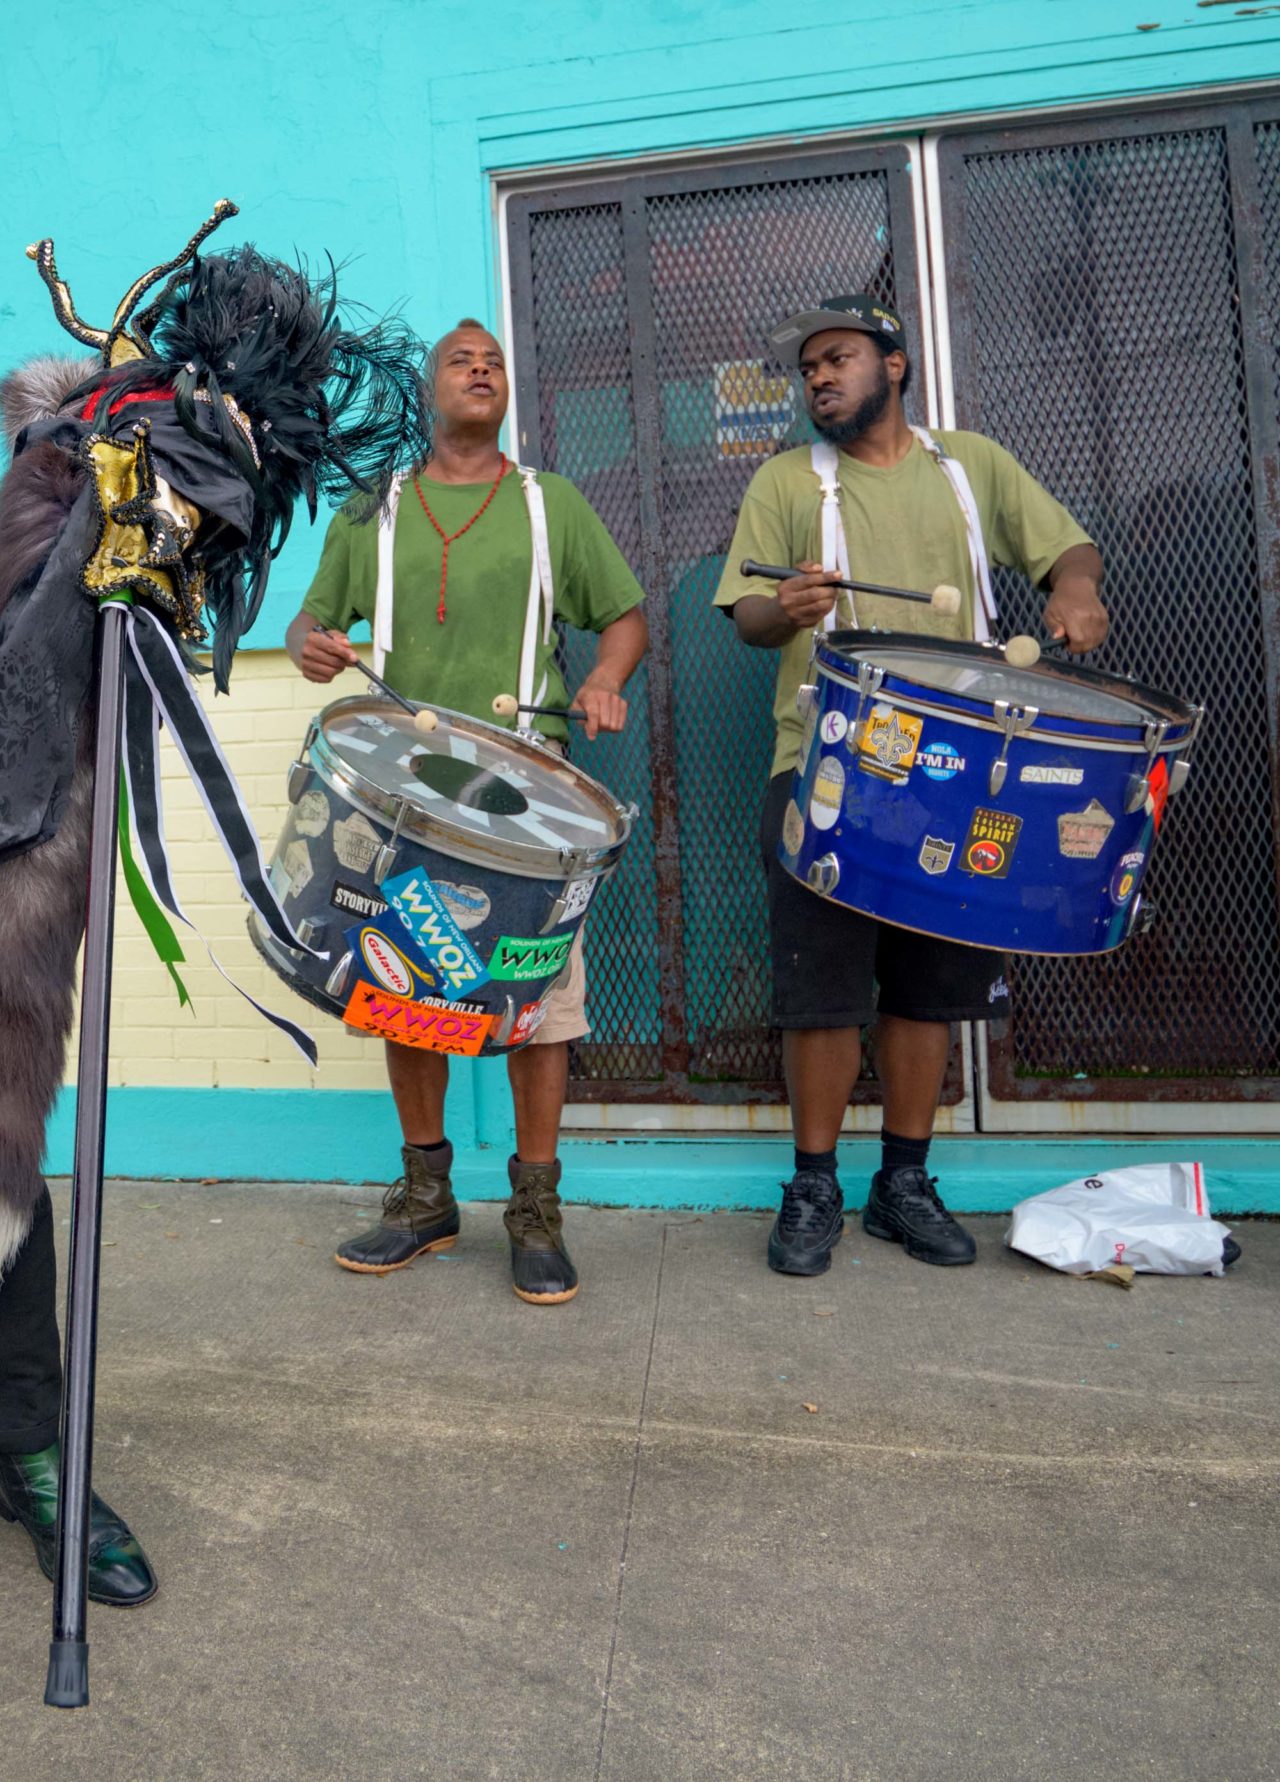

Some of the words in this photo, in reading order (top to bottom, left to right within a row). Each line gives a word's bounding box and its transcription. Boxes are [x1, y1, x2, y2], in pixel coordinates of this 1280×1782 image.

[872, 307, 903, 331] SAINTS
[916, 752, 942, 768] I'M
[945, 756, 965, 771] IN
[1022, 768, 1083, 784] SAINTS
[972, 824, 1014, 843] SPIRIT
[399, 878, 477, 989] WWOZ
[422, 880, 444, 913] SOUNDS
[442, 913, 452, 924] OF
[448, 924, 463, 943] NEW
[460, 942, 483, 973] ORLEANS
[367, 937, 406, 990] Galactic
[376, 991, 409, 1007] SOUNDS
[369, 998, 483, 1040] WWOZ
[364, 1022, 420, 1043] 90.7
[432, 1041, 465, 1055] FM
